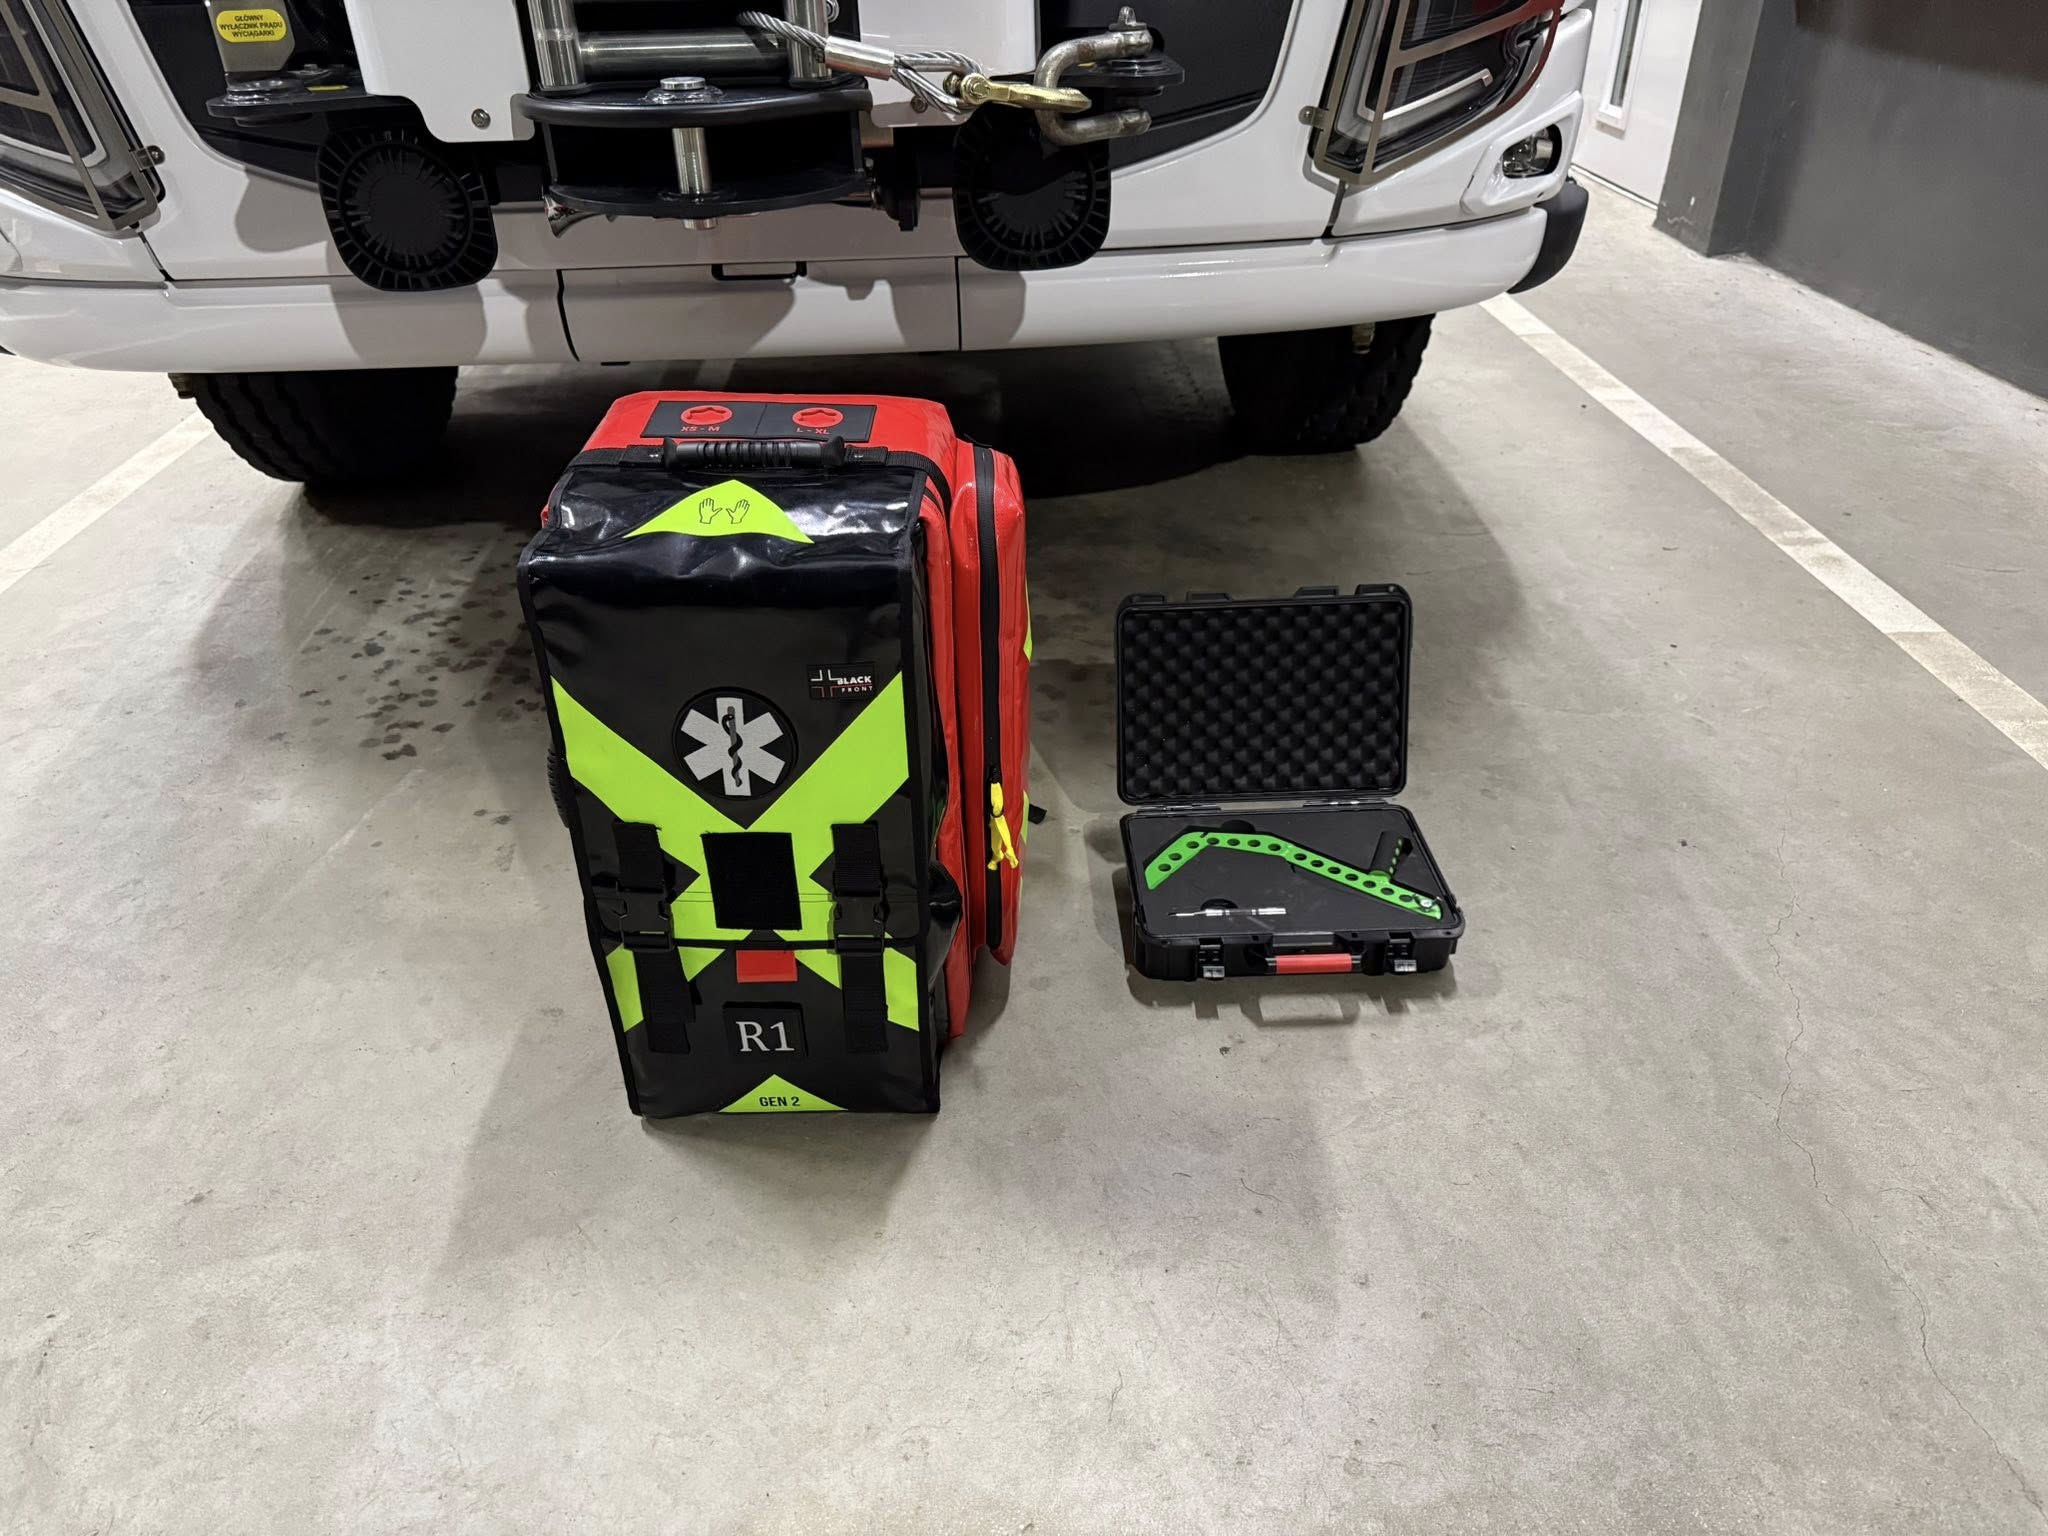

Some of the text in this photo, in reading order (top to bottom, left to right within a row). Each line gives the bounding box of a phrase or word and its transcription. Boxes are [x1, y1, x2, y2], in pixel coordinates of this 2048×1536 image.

[837, 676, 872, 685] BLACK
[735, 1021, 795, 1052] R1
[759, 1096, 801, 1107] GEN 2
